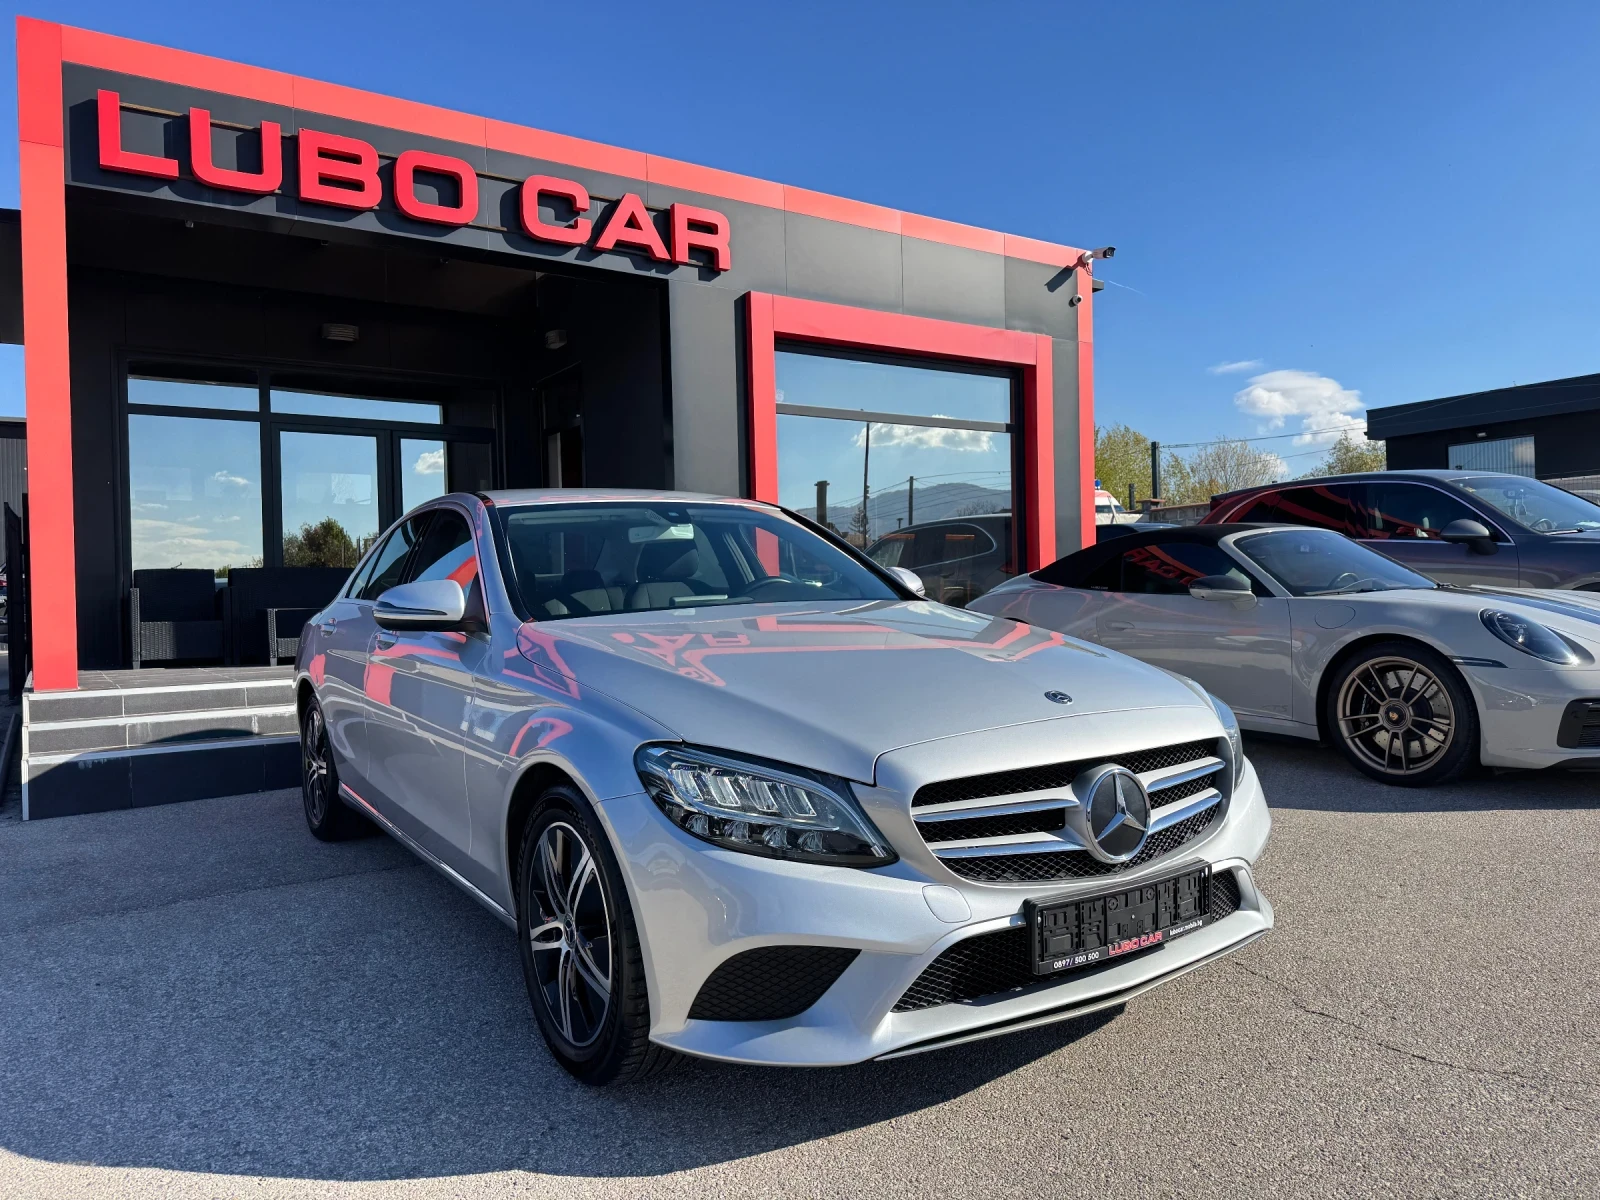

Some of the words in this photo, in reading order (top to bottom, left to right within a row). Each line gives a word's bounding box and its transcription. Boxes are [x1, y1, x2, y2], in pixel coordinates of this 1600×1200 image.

[97, 88, 479, 226] LUBO
[519, 174, 732, 272] CAR
[1108, 938, 1139, 956] LUBO
[1140, 931, 1163, 947] CAR
[1074, 954, 1086, 964] 500
[1087, 951, 1100, 961] 500
